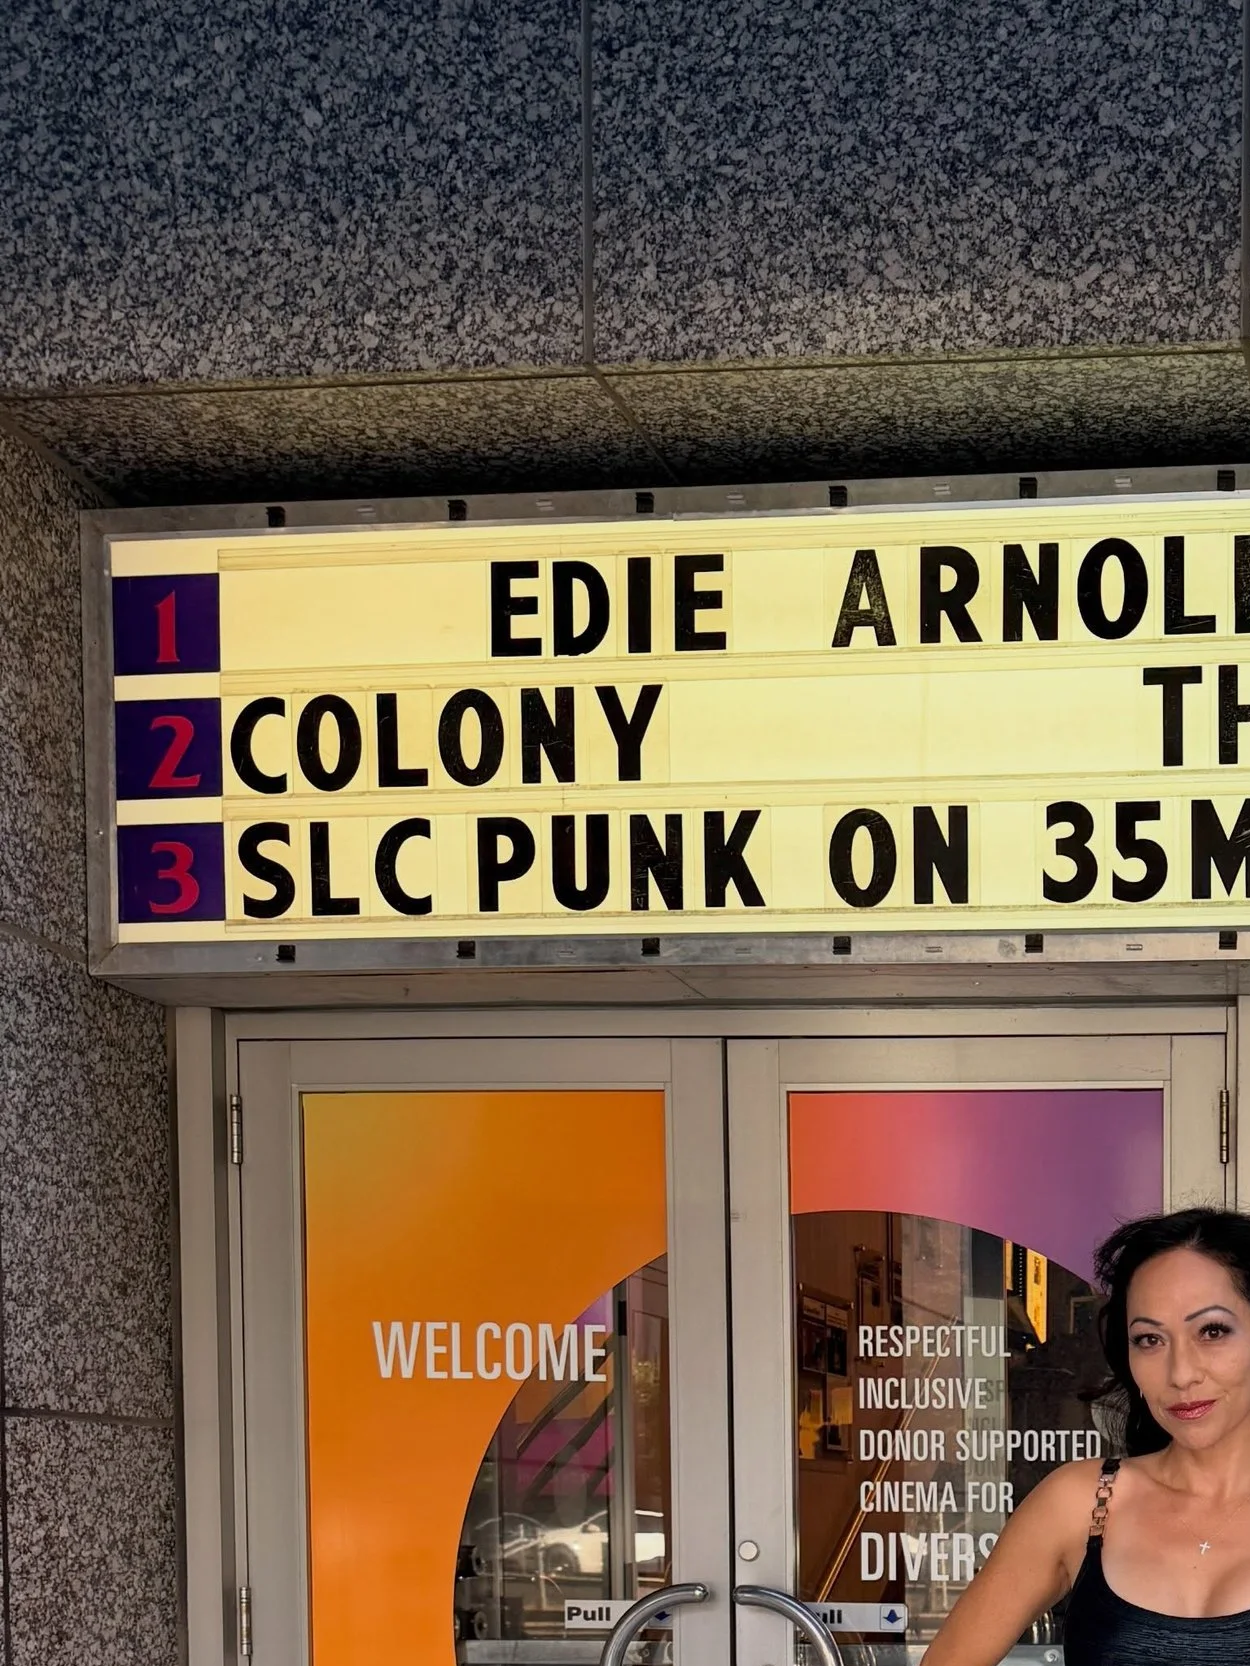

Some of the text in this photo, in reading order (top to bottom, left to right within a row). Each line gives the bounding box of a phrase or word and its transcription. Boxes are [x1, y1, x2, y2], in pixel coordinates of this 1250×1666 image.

[155, 590, 180, 663] 1
[491, 554, 726, 657] EDIE
[149, 715, 201, 788] 2
[231, 685, 662, 794] COLONY
[149, 841, 200, 914] 3
[238, 818, 432, 918] SLC
[478, 810, 765, 912] PUNK
[829, 806, 968, 907] ON
[373, 1321, 607, 1382] WELCOME
[859, 1325, 1011, 1358] RESPECTFUL
[859, 1377, 987, 1410] INCLUSIVE
[860, 1429, 1101, 1462] DONOR SUPPORTED
[860, 1481, 1014, 1513] CINEMA FOR
[861, 1532, 1000, 1582] DIVERS
[567, 1606, 611, 1622] Pull
[816, 1609, 842, 1624] ull
